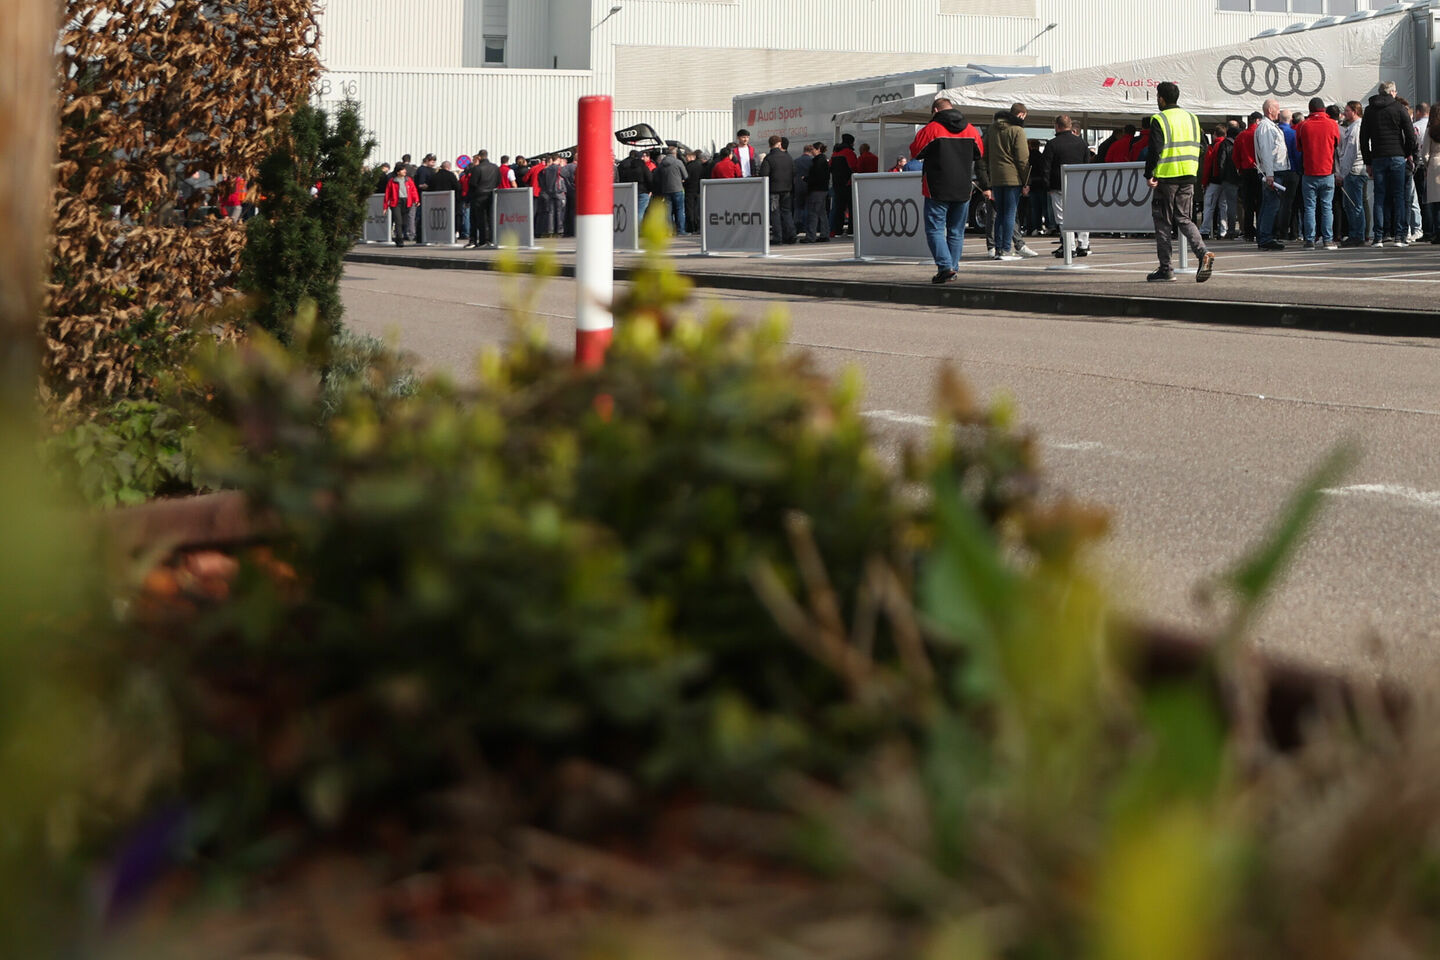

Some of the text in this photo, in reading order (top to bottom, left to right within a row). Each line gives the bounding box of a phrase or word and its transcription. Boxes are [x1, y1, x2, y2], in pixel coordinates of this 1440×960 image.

[340, 79, 358, 96] 16
[1118, 78, 1143, 87] Audi
[758, 105, 803, 123] Audi Sport
[788, 126, 808, 138] racing
[709, 210, 762, 226] e-tron
